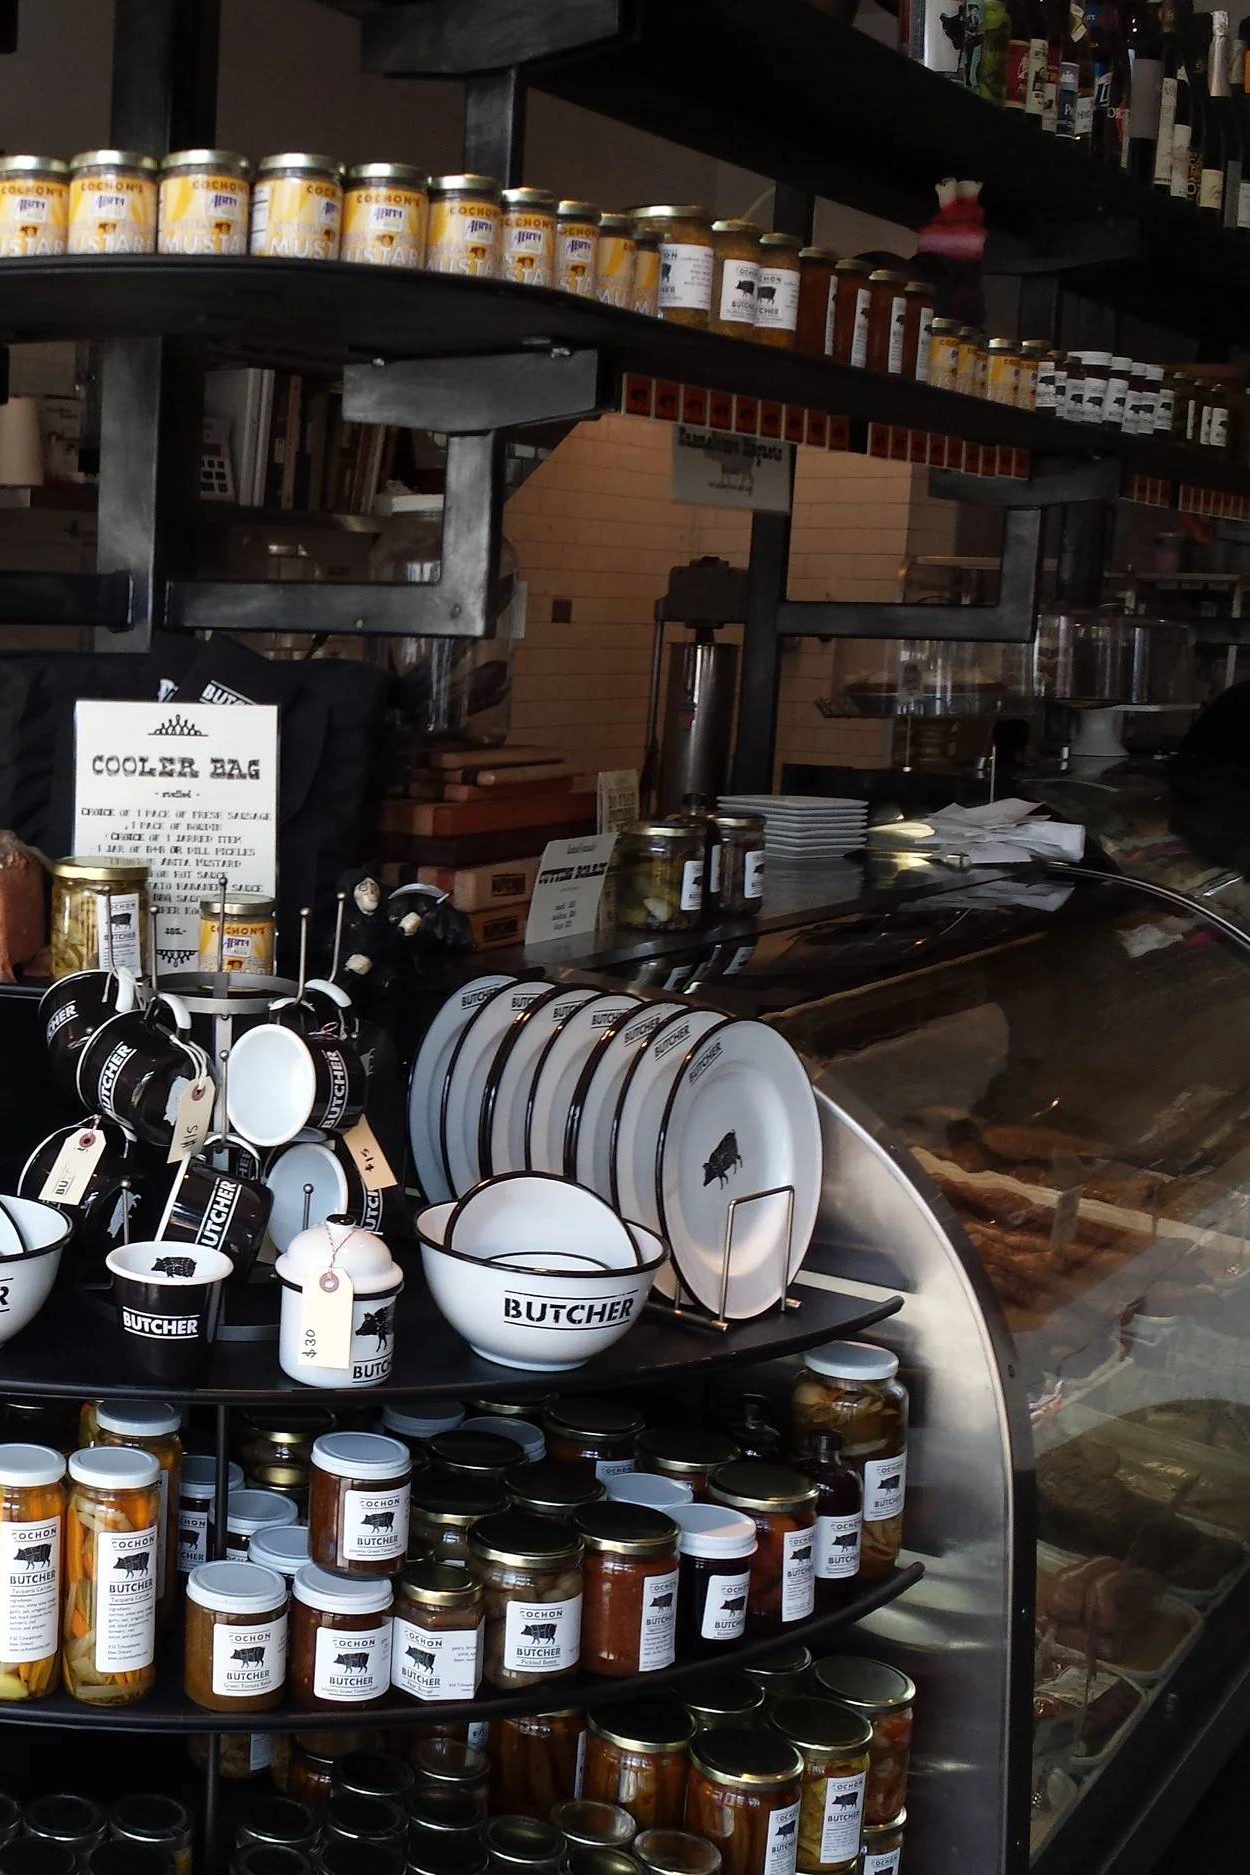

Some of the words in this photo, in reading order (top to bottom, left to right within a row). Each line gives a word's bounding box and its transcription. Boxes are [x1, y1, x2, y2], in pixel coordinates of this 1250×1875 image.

[81, 180, 144, 194] COCHON'S
[192, 180, 242, 192] COCHO
[306, 184, 337, 197] COCH
[75, 235, 151, 253] USTAR
[165, 235, 241, 254] MUSTA
[270, 239, 334, 259] MUST
[350, 245, 418, 266] USTAR
[91, 754, 199, 779] COOLER
[209, 756, 261, 781] BAG
[80, 807, 115, 818] CHOICE
[119, 808, 131, 818] OF
[175, 810, 187, 819] OF
[191, 810, 223, 820] FRESH
[227, 811, 273, 821] SAUSAGE
[170, 822, 181, 831] OF
[110, 832, 145, 842] CHOICE
[149, 833, 161, 842] OF
[217, 835, 242, 845] ITEM
[105, 844, 125, 854] JAR
[129, 845, 141, 854] OF
[169, 845, 182, 855] OR
[186, 846, 210, 856] DILL
[214, 847, 256, 857] PICKLES
[160, 858, 190, 867] ABITA
[195, 859, 242, 869] MUSTARD
[197, 871, 228, 880] SAUCE
[231, 884, 264, 894] SAUCE
[176, 893, 201, 903] SAUC
[110, 902, 136, 911] OCHON
[103, 931, 136, 942] BTCHER
[511, 996, 539, 1009] BUTC
[48, 1004, 77, 1037] CHER
[623, 1015, 661, 1043] BUTCHER
[654, 1024, 691, 1058] BUTCHER
[688, 1041, 723, 1083] BUTCHER
[322, 1049, 348, 1129] BUTCHER
[201, 1180, 237, 1248] UTCHER
[503, 1295, 635, 1326] BUTCHER
[122, 1311, 199, 1336] BUTCHER
[352, 1361, 391, 1381] BUTC
[602, 1466, 632, 1475] OCHO
[359, 1497, 400, 1508] COCHON
[11, 1527, 57, 1541] COCHON
[357, 1534, 399, 1546] BUTCHER
[111, 1535, 155, 1549] COCHON
[181, 1552, 205, 1562] CHER
[9, 1569, 57, 1586] BUTCHER
[108, 1577, 154, 1594] BUTCHER
[520, 1609, 563, 1619] COCHON
[228, 1632, 271, 1642] COCHON
[332, 1638, 375, 1648] COCHON
[404, 1629, 443, 1648] COCHON
[516, 1647, 561, 1658] BUTCHER
[521, 1658, 541, 1666] Pickled
[226, 1669, 270, 1681] BUTCHER
[329, 1676, 374, 1686] BUTCHER
[402, 1667, 441, 1687] BUTCHER
